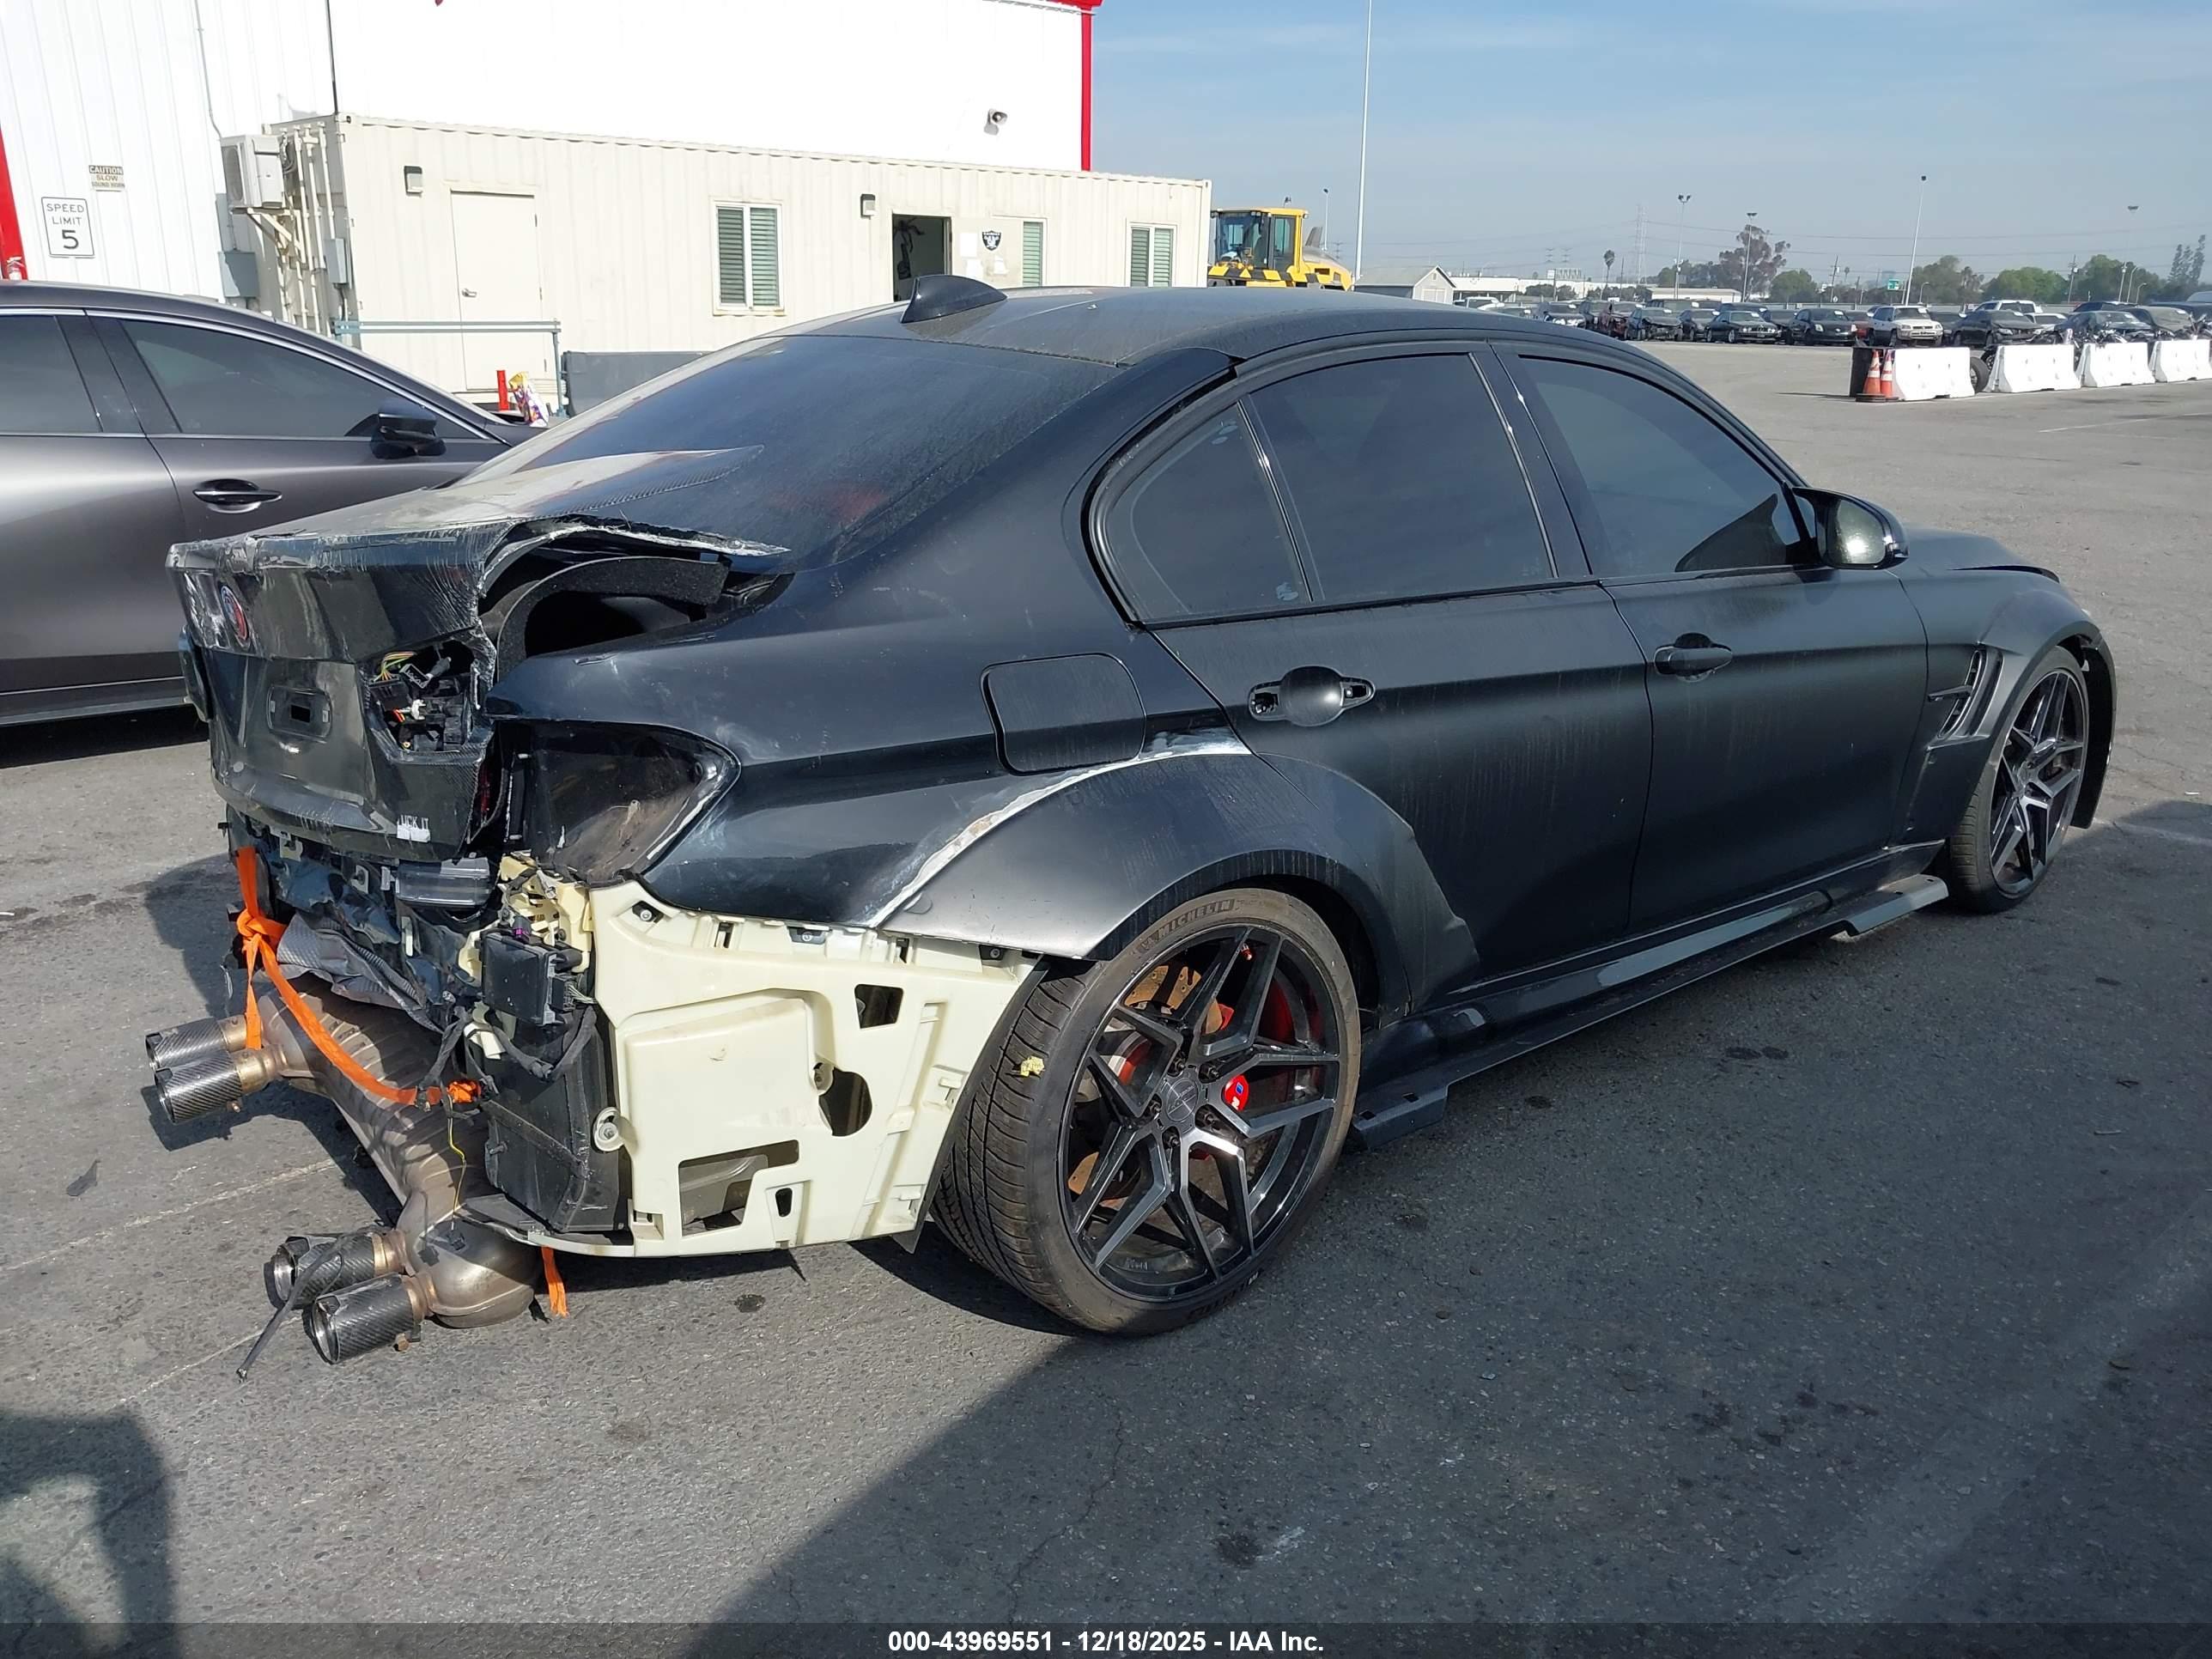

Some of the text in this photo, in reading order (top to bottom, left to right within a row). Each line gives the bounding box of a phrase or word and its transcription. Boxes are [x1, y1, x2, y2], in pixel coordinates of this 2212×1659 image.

[89, 165, 123, 174] CAUTION
[46, 203, 84, 213] SPEED
[52, 216, 82, 226] LIMIT
[61, 229, 79, 250] 5
[1159, 899, 1235, 938] MICHELIN
